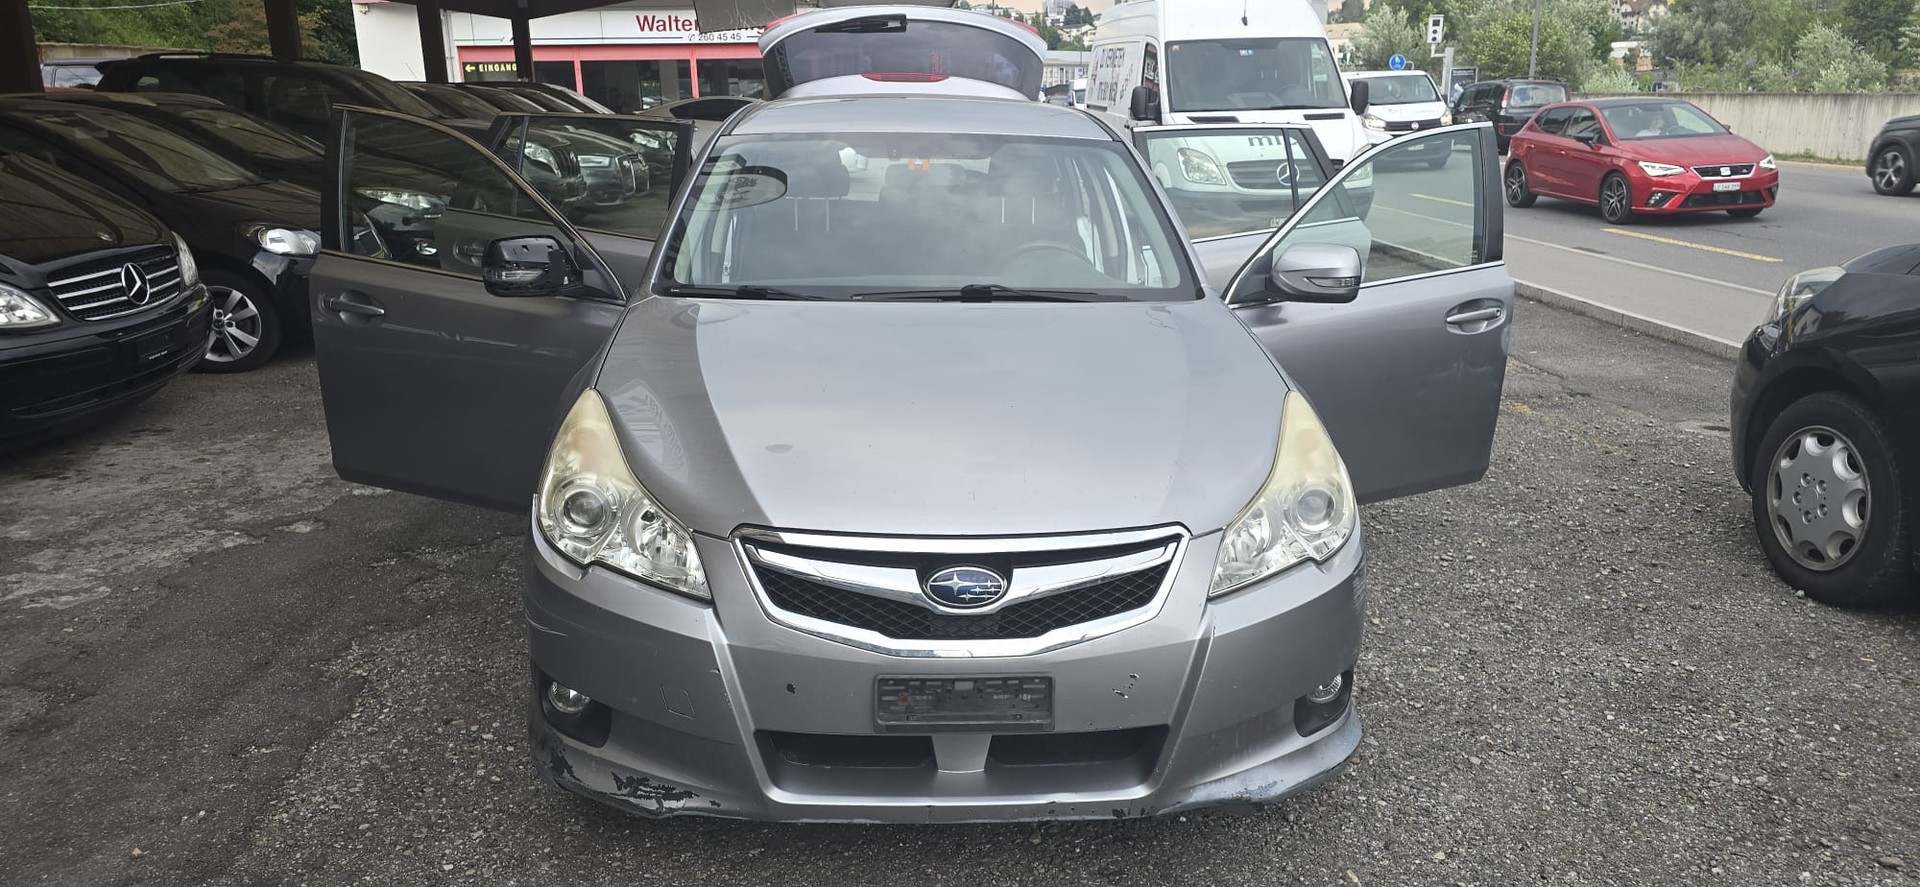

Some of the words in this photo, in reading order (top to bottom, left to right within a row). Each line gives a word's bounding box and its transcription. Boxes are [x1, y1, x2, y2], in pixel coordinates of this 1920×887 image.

[698, 33, 714, 41] 260
[717, 33, 728, 41] 45
[479, 63, 517, 72] EINGANG
